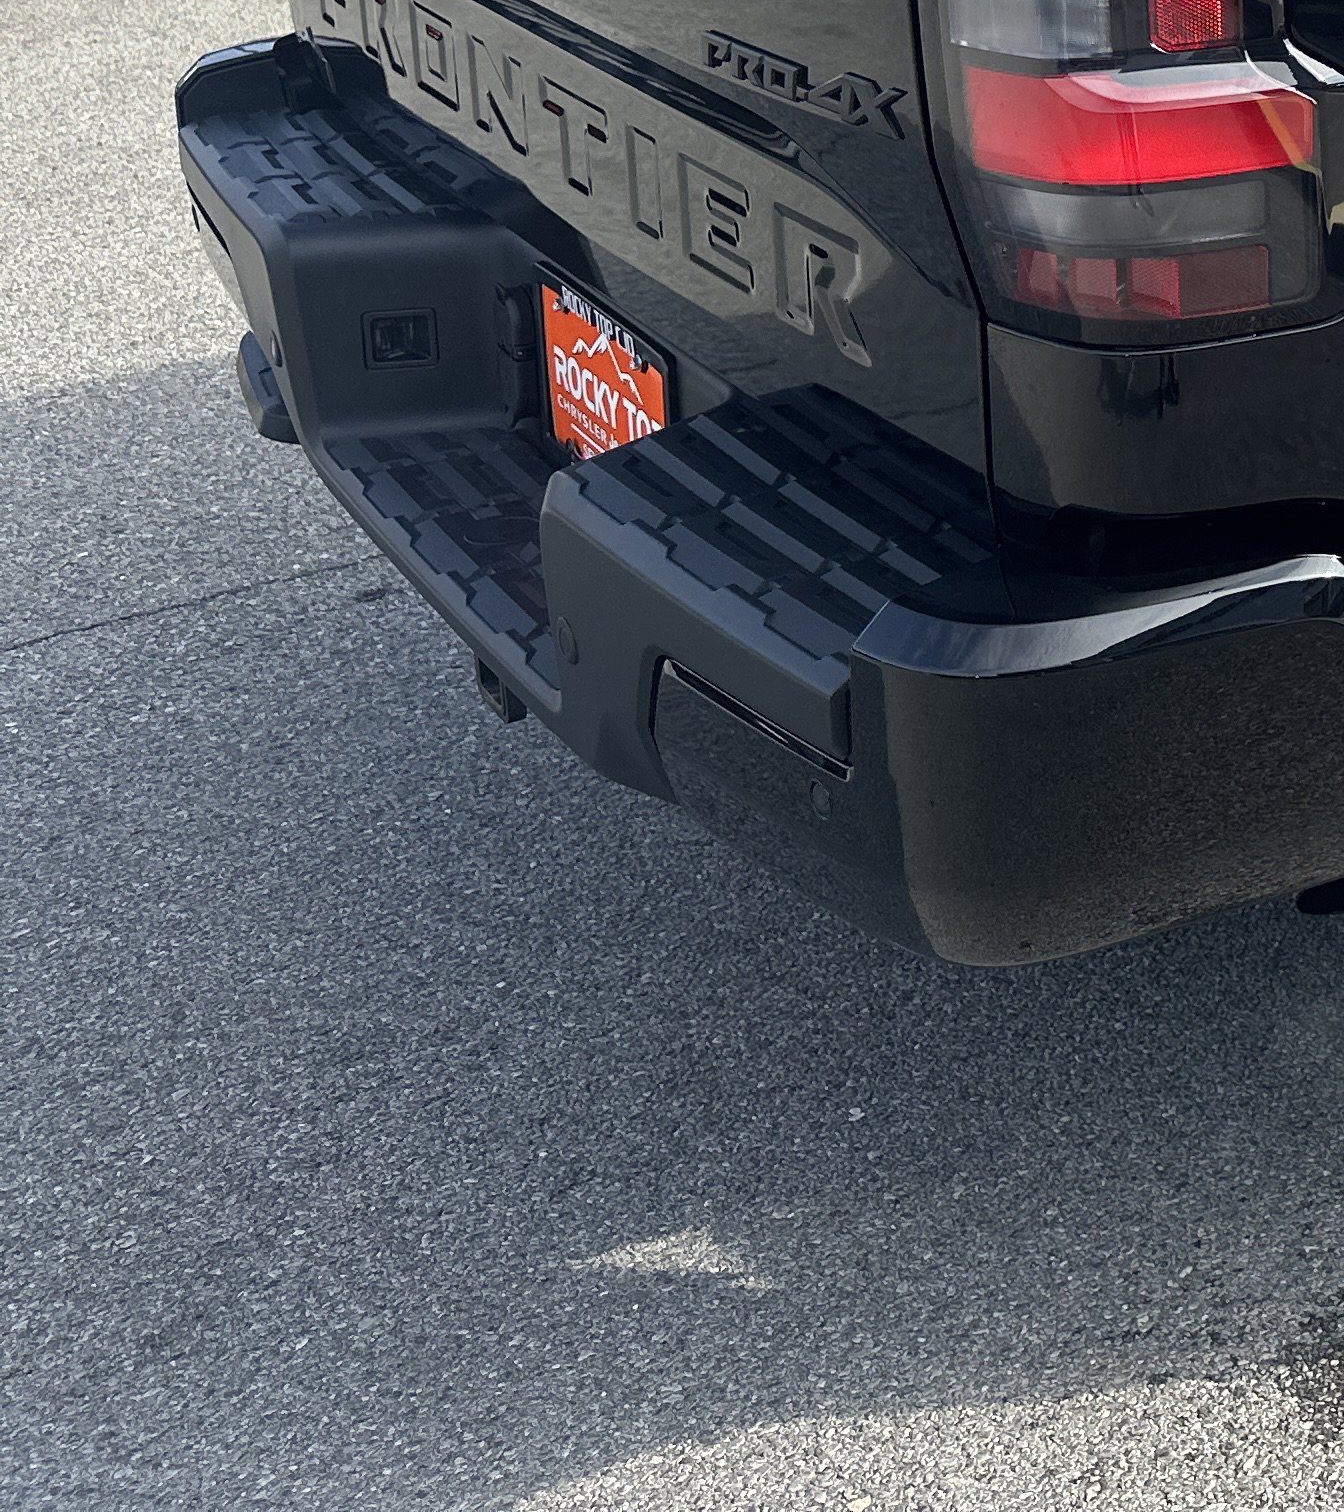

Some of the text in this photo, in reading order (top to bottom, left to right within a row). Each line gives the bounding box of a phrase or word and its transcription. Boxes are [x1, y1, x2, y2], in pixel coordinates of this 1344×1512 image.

[701, 29, 909, 141] PRO-4X
[561, 285, 593, 326] ROCKY
[593, 310, 614, 340] TOP
[553, 344, 665, 442] ROCKY TO
[556, 393, 608, 445] CHRYSLER
